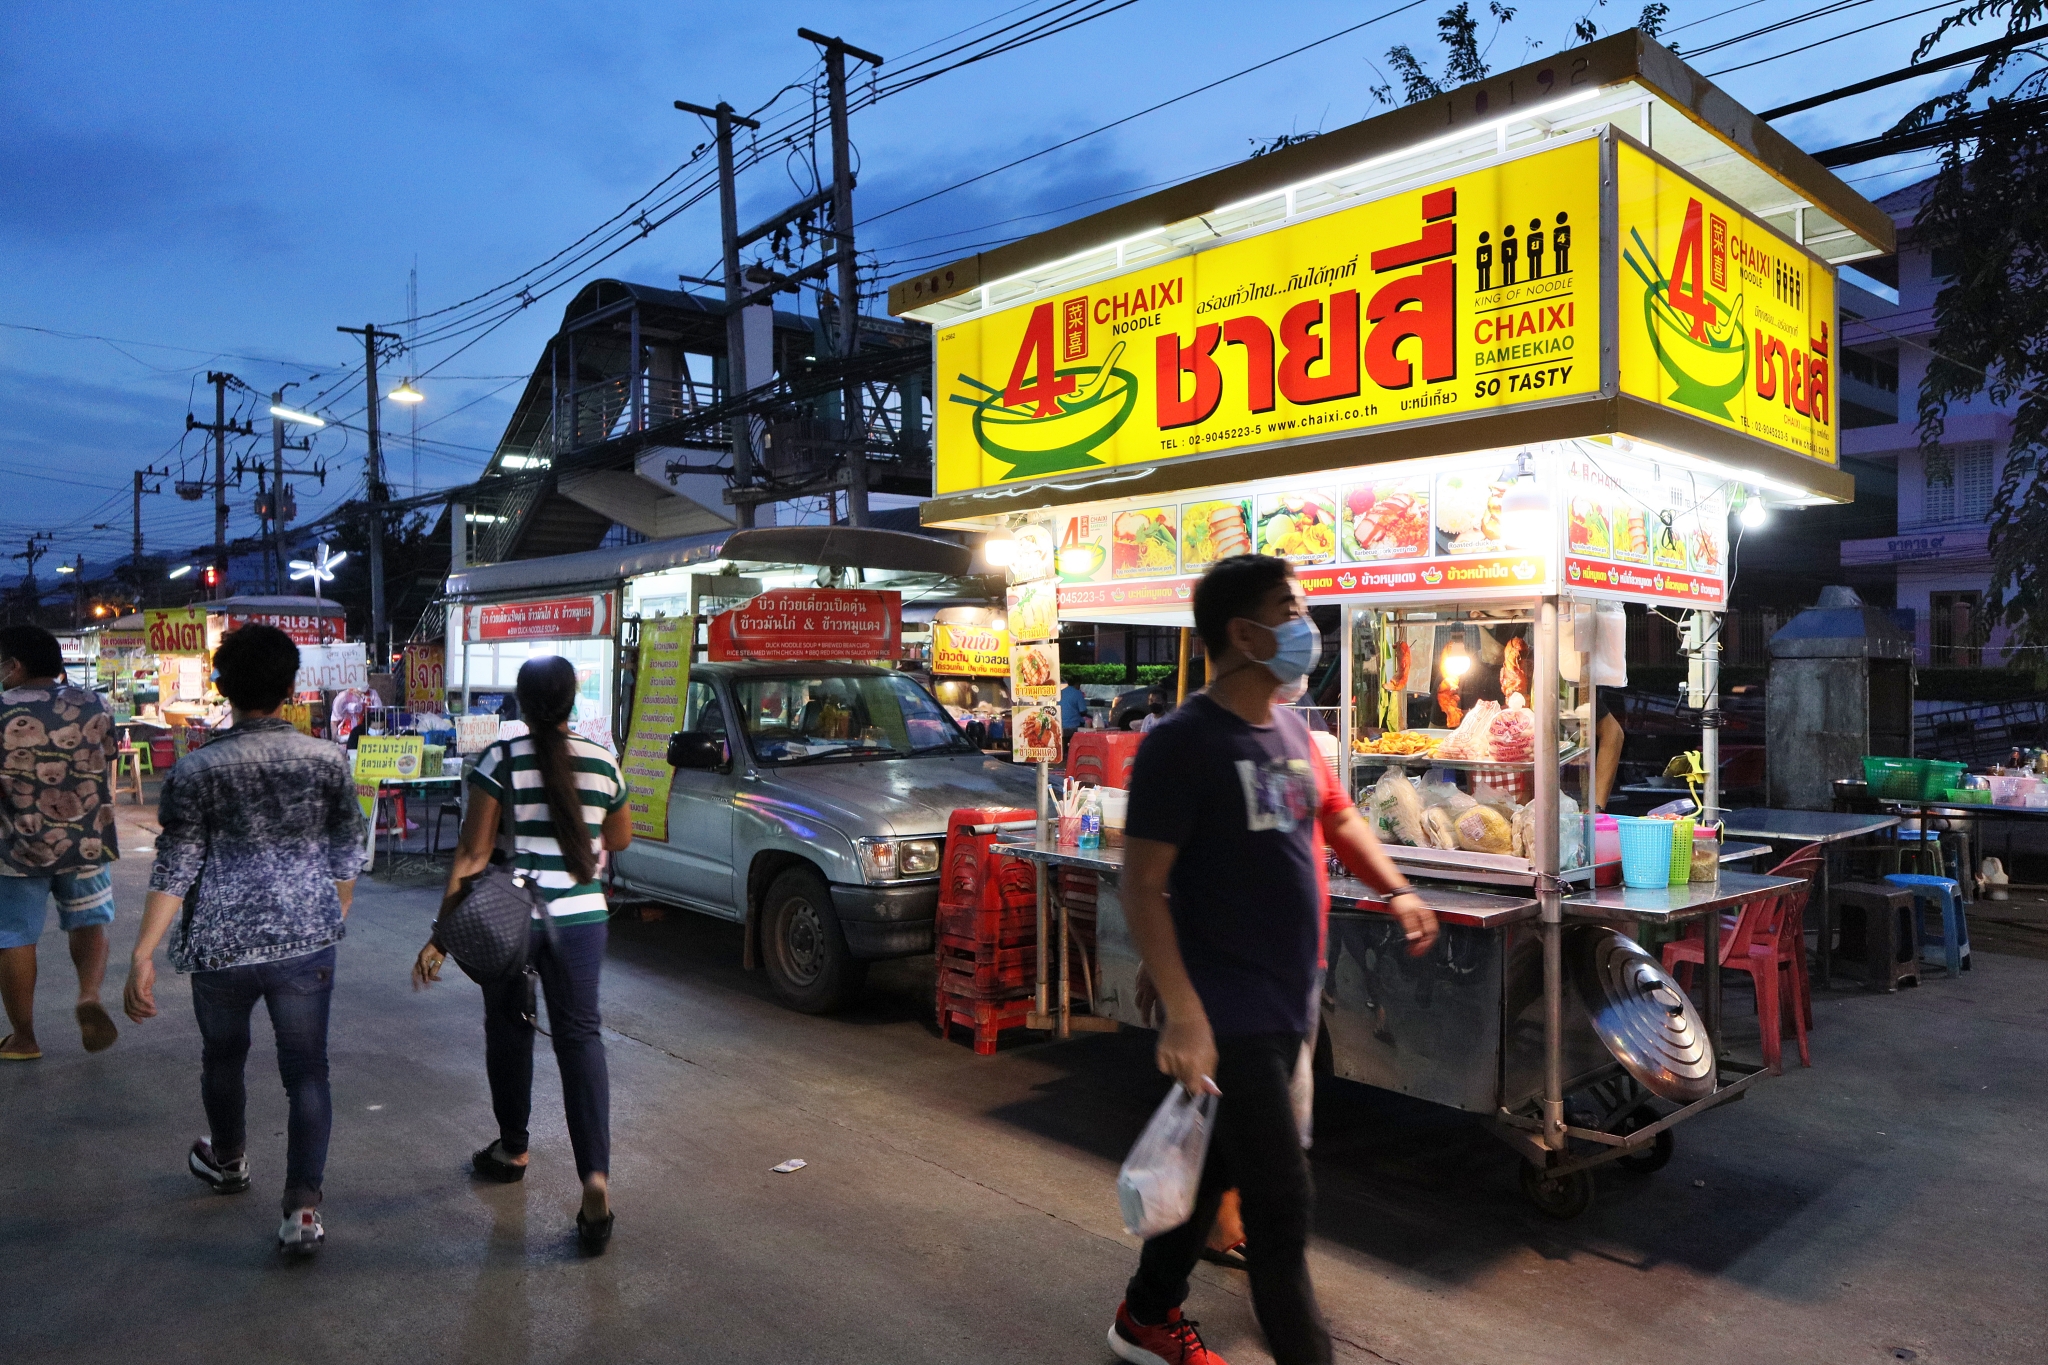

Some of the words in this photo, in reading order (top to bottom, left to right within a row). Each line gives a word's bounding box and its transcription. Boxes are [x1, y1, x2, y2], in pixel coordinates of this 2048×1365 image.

[1668, 197, 1716, 345] 4
[1730, 235, 1770, 279] CHAIXI
[1475, 293, 1501, 307] KING
[1506, 288, 1521, 301] OF
[1526, 278, 1574, 296] NOODLE
[1740, 269, 1762, 289] NOODLE
[1094, 277, 1183, 325] CHAIXI
[1156, 187, 1457, 431] ชายสี่
[1112, 313, 1162, 336] NOODLE
[1474, 302, 1575, 344] CHAIXI
[1003, 301, 1076, 418] 4
[1475, 335, 1574, 366] BAMEEKIAO
[1475, 378, 1501, 398] SO
[1508, 365, 1573, 393] TASTY
[1755, 320, 1829, 426] ชายสี่
[1161, 438, 1178, 450] TEL
[1188, 425, 1262, 445] 02-9045223-5
[1268, 406, 1378, 432] www.chaixi.co.th
[1740, 415, 1750, 428] TEL
[1754, 421, 1789, 442] 02-9045223-5
[1361, 572, 1417, 587] ข้าวหมูแดง
[1447, 562, 1509, 580] ข้าวหน้าเป็ด
[758, 597, 775, 611] บิว
[149, 611, 206, 652] ส้มตำ
[740, 613, 796, 630] ข้าวมันไก่
[803, 618, 814, 631] &
[822, 616, 881, 635] ข้าวหมูแดง
[808, 649, 819, 657] BBQ
[939, 649, 969, 662] ข้าวต้ม
[974, 652, 1009, 665] ข้าวสวย
